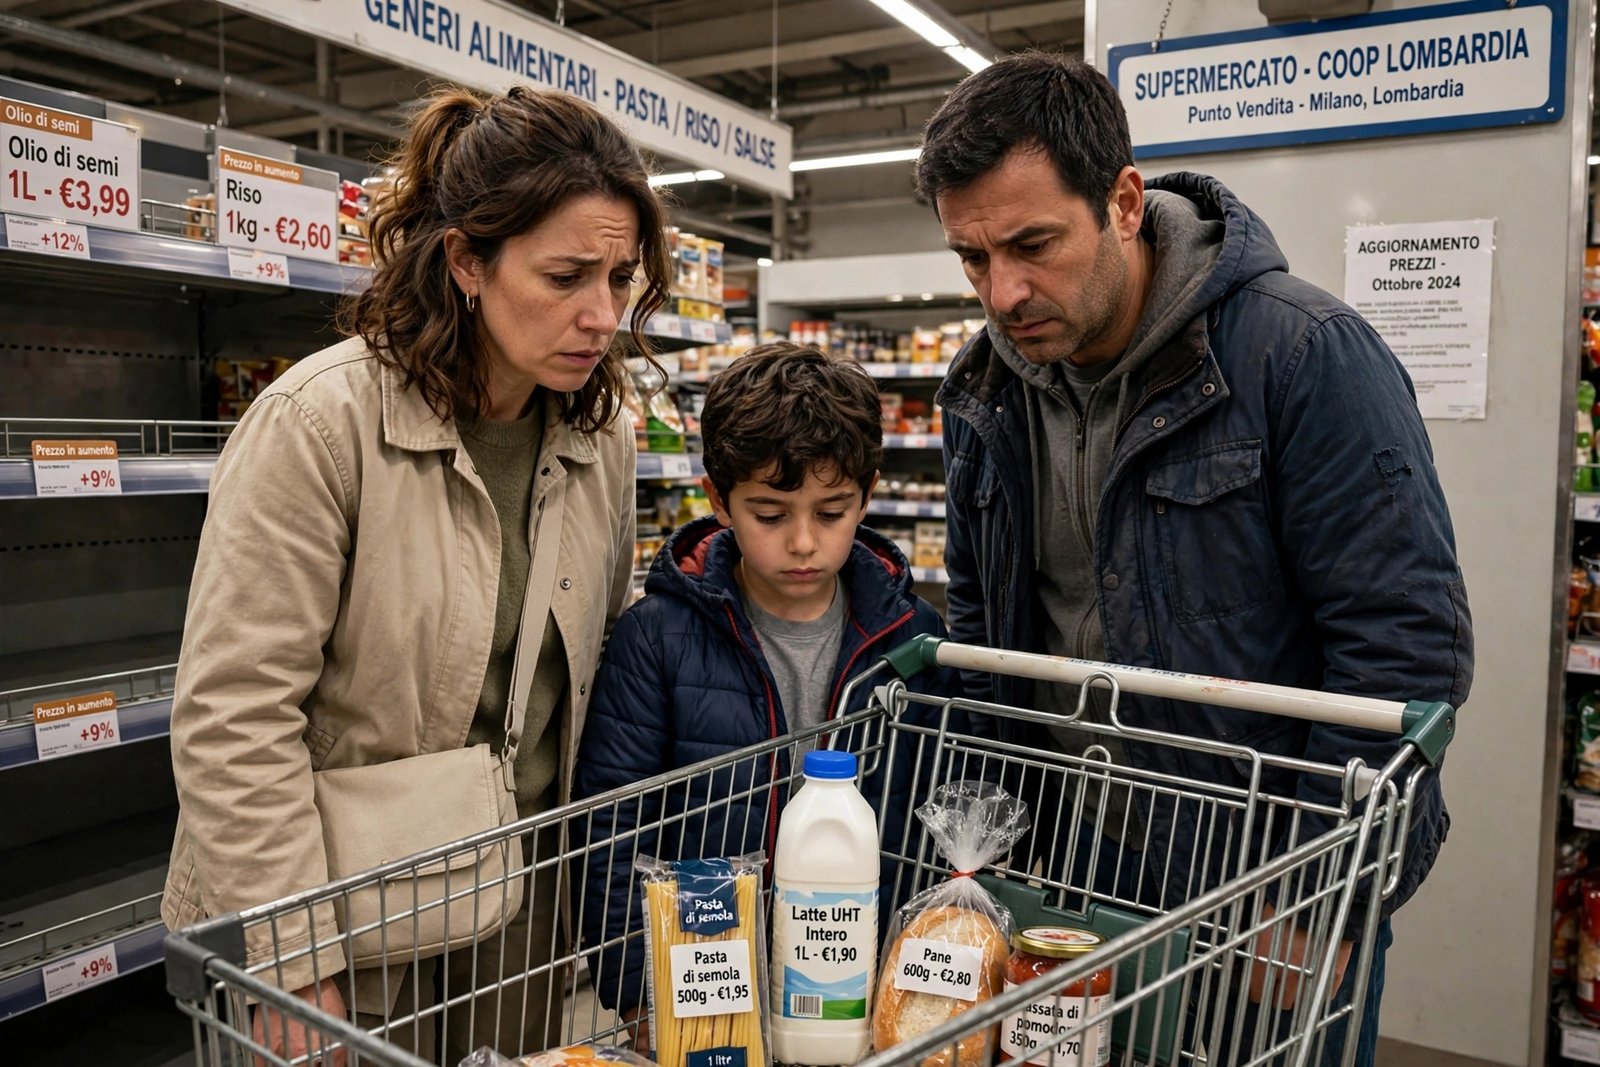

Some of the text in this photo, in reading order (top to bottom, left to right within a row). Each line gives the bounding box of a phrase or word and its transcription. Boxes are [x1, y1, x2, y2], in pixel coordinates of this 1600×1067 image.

[1135, 55, 1297, 101] SUPERMERCATO
[1317, 46, 1380, 80] COOP
[1387, 27, 1530, 73] LOMBARDIA
[365, 0, 460, 52] GENERI
[469, 20, 597, 102] ALIMENTARI
[615, 78, 669, 130] PASTA
[673, 101, 681, 137] /
[685, 106, 721, 148] RISO
[724, 122, 732, 155] /
[734, 126, 776, 170] SALSE
[1188, 104, 1232, 124] Punto
[1237, 97, 1294, 118] Vendita
[1309, 92, 1367, 112] Milano,
[1373, 79, 1464, 105] Lombardia
[5, 105, 80, 134] Olio di semi
[8, 135, 119, 177] Olio di semi
[223, 153, 300, 181] Prezzo in aumento
[8, 169, 37, 201] 1L
[59, 177, 130, 217] €3,99
[226, 178, 262, 204] Riso
[226, 209, 257, 243] 1kg
[275, 216, 331, 250] €2,60
[41, 231, 84, 252] +12%
[1358, 236, 1480, 254] AGGIORNAMENTO
[256, 262, 285, 279] +9%
[1389, 257, 1436, 272] PREZZI
[1372, 276, 1461, 291] Ottobre 2024
[35, 444, 115, 456] Prezzo in aumento
[80, 470, 115, 488] +9%
[36, 697, 113, 719] Prezzo in aumento
[80, 721, 114, 741] +9%
[695, 899, 724, 910] Pasta
[685, 910, 734, 924] di semola
[791, 906, 861, 922] Latte UHT
[805, 926, 848, 942] Intero
[694, 951, 728, 965] Pasta
[794, 946, 809, 961] 1L
[821, 946, 857, 965] €1,90
[923, 948, 952, 964] Pane
[81, 955, 112, 978] +9%
[683, 966, 740, 984] di semola
[903, 964, 931, 982] 600g
[940, 970, 971, 986] €2,80
[677, 988, 707, 1005] 500g
[717, 984, 749, 1002] €1,95
[1024, 1003, 1079, 1019] assata di
[1055, 1041, 1081, 1057] 1,70
[708, 1056, 713, 1067] 1
